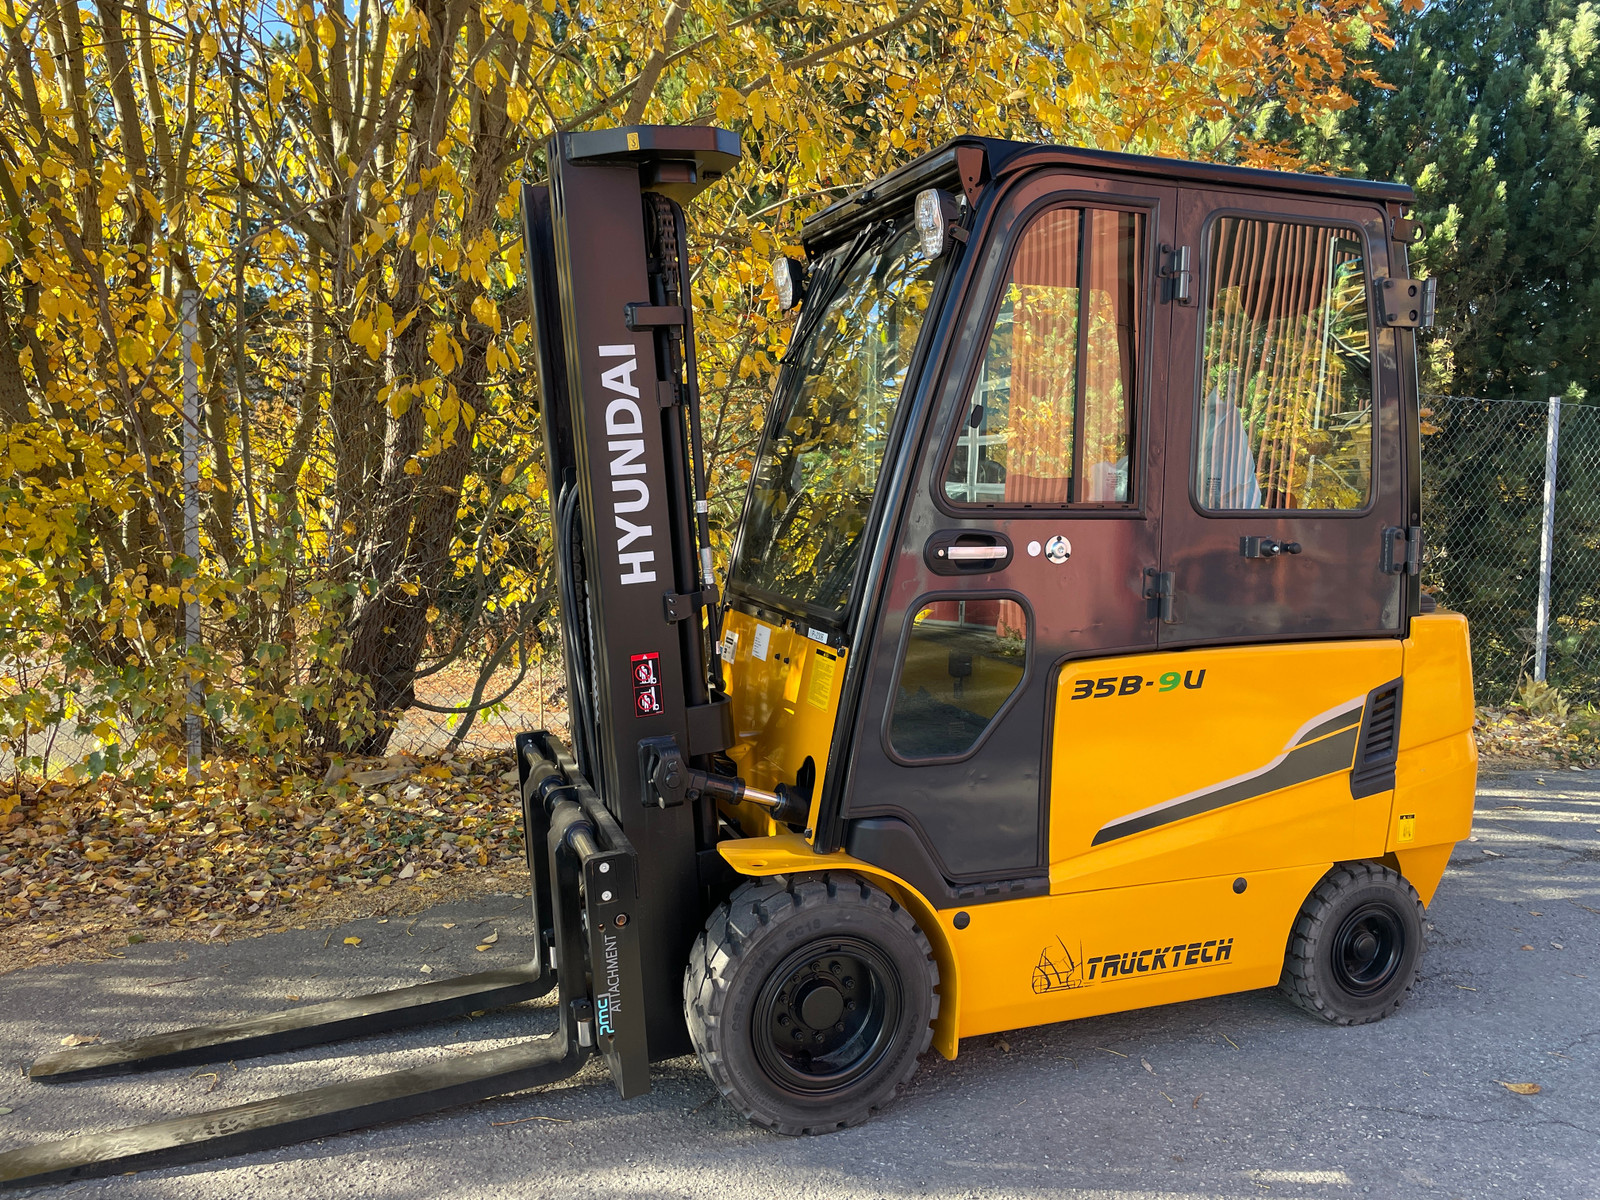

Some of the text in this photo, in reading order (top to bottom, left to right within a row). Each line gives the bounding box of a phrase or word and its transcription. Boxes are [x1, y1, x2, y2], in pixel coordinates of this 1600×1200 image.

[598, 343, 657, 585] HYUNDAI
[1071, 669, 1207, 700] 35B-9U
[604, 934, 622, 1012] ATTACHMENT
[1086, 937, 1234, 980] TRUCKTECH
